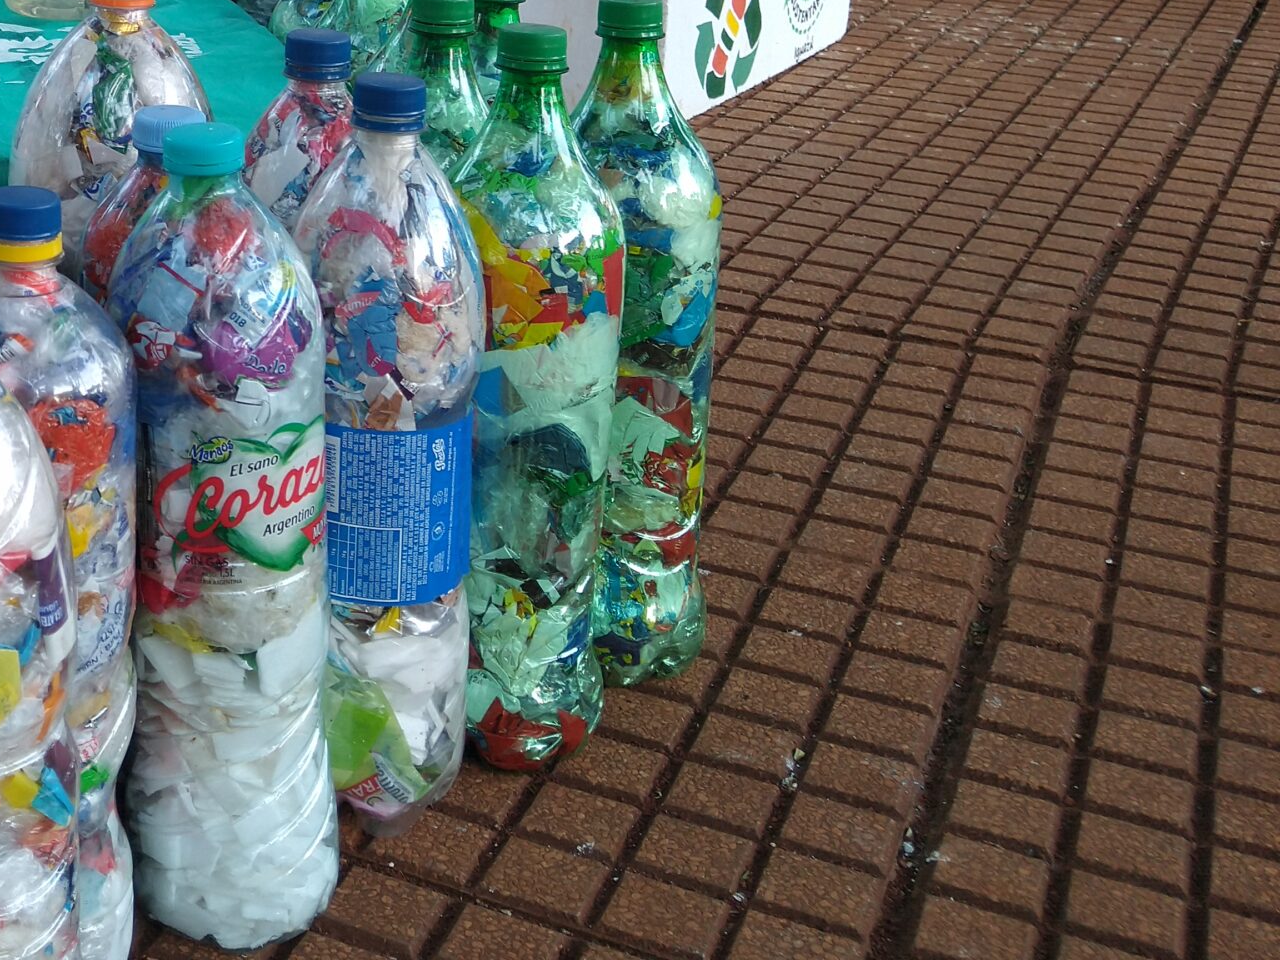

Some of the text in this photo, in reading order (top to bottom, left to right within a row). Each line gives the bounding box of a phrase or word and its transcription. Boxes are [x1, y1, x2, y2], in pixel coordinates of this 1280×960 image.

[230, 454, 279, 476] El sano
[181, 453, 325, 539] Coraz
[262, 505, 317, 538] Argentino
